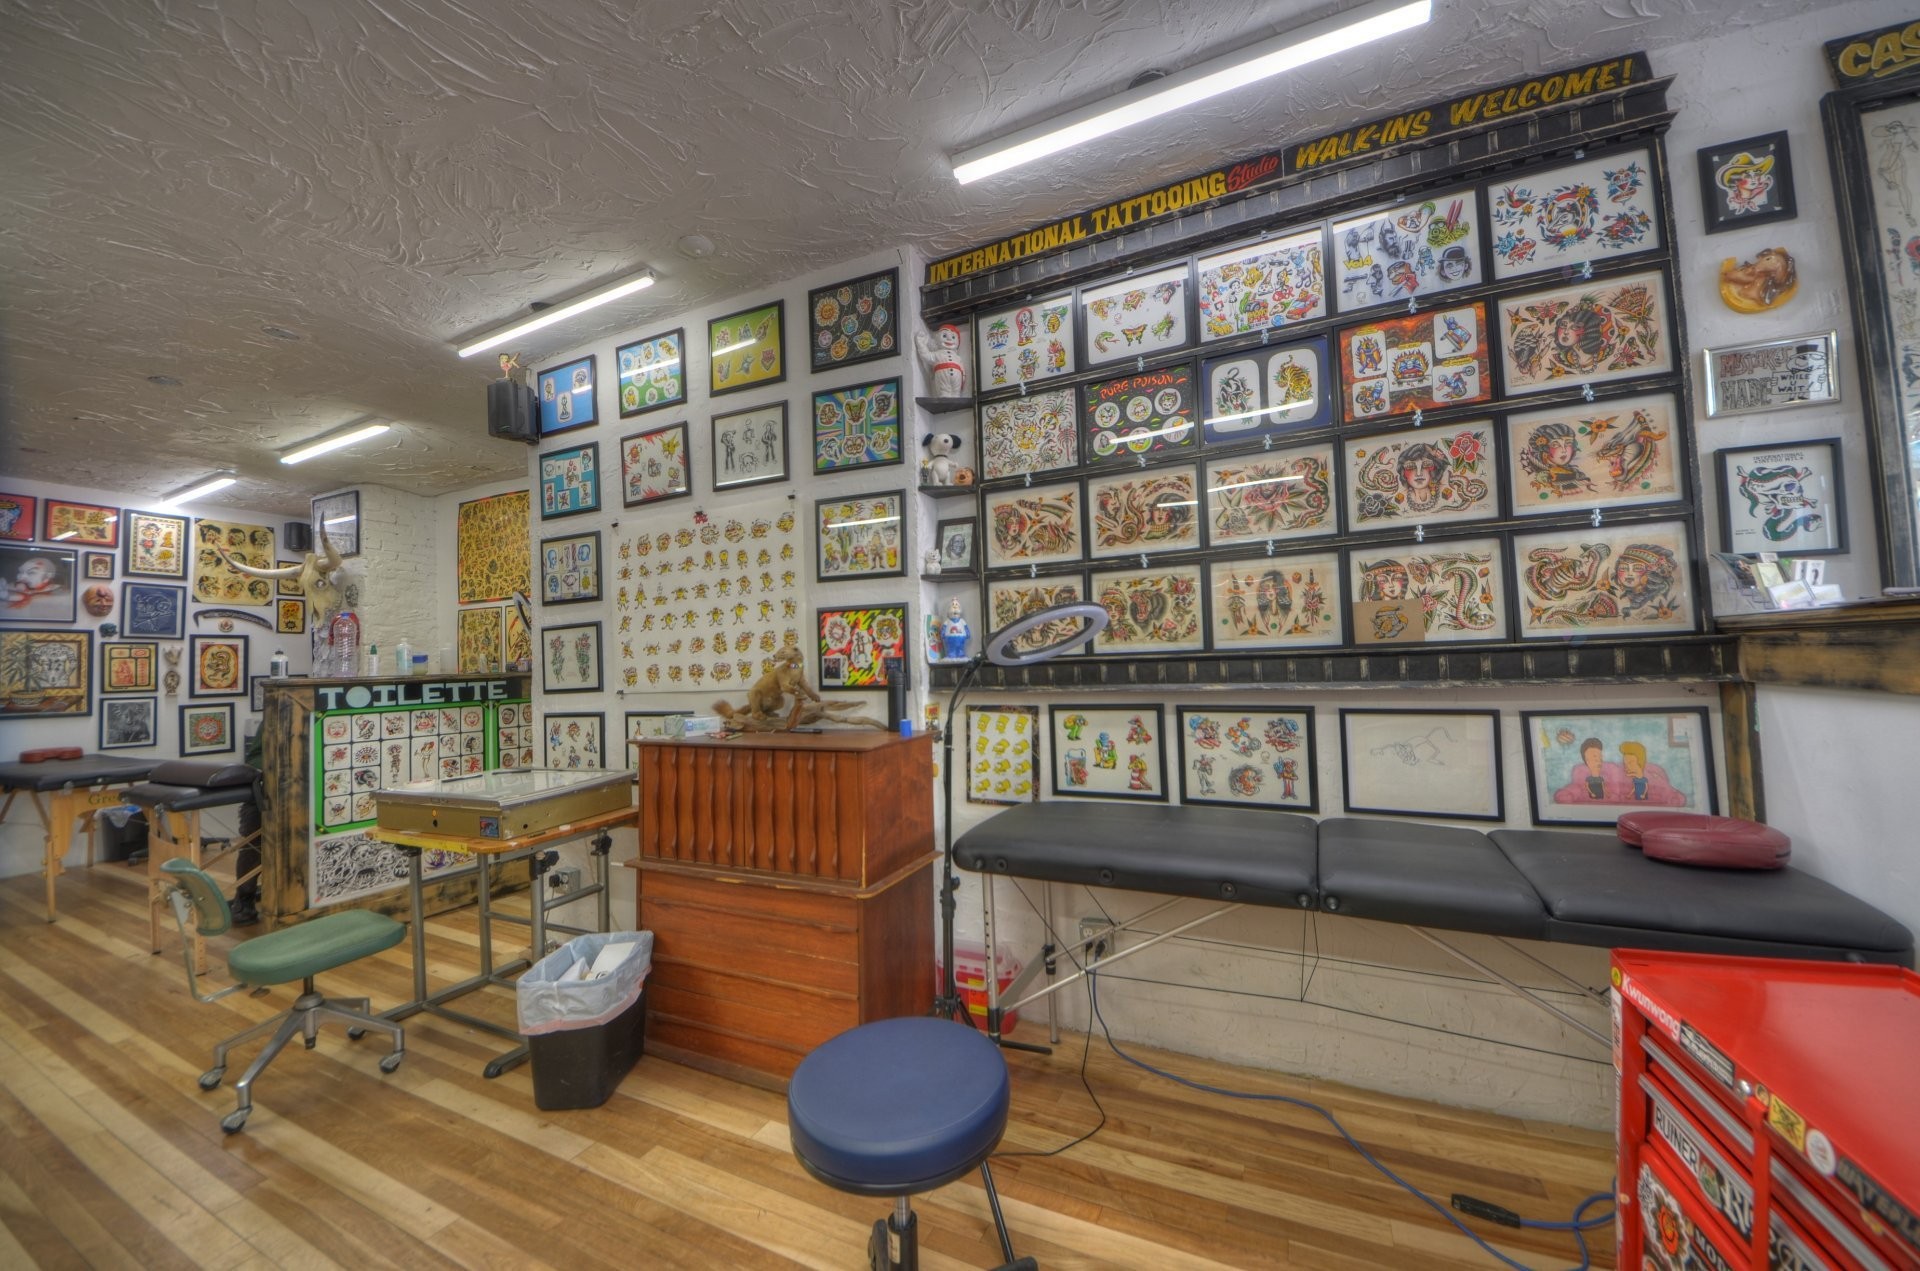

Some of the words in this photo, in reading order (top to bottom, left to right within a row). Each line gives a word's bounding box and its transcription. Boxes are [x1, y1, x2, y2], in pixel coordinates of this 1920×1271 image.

[1295, 110, 1432, 169] WALK-INS
[1449, 59, 1633, 126] WELCOME!
[930, 213, 1087, 284] INTERNATIONAL
[1091, 172, 1226, 235] TATTOOING
[1227, 156, 1280, 191] Studio
[1100, 379, 1129, 399] PURE
[1133, 375, 1174, 389] POISON
[1780, 373, 1810, 381] WHILE
[1753, 452, 1804, 461] INTERNATIONAL
[319, 681, 508, 709] TOILETTE
[1655, 1105, 1699, 1174] RUINER
